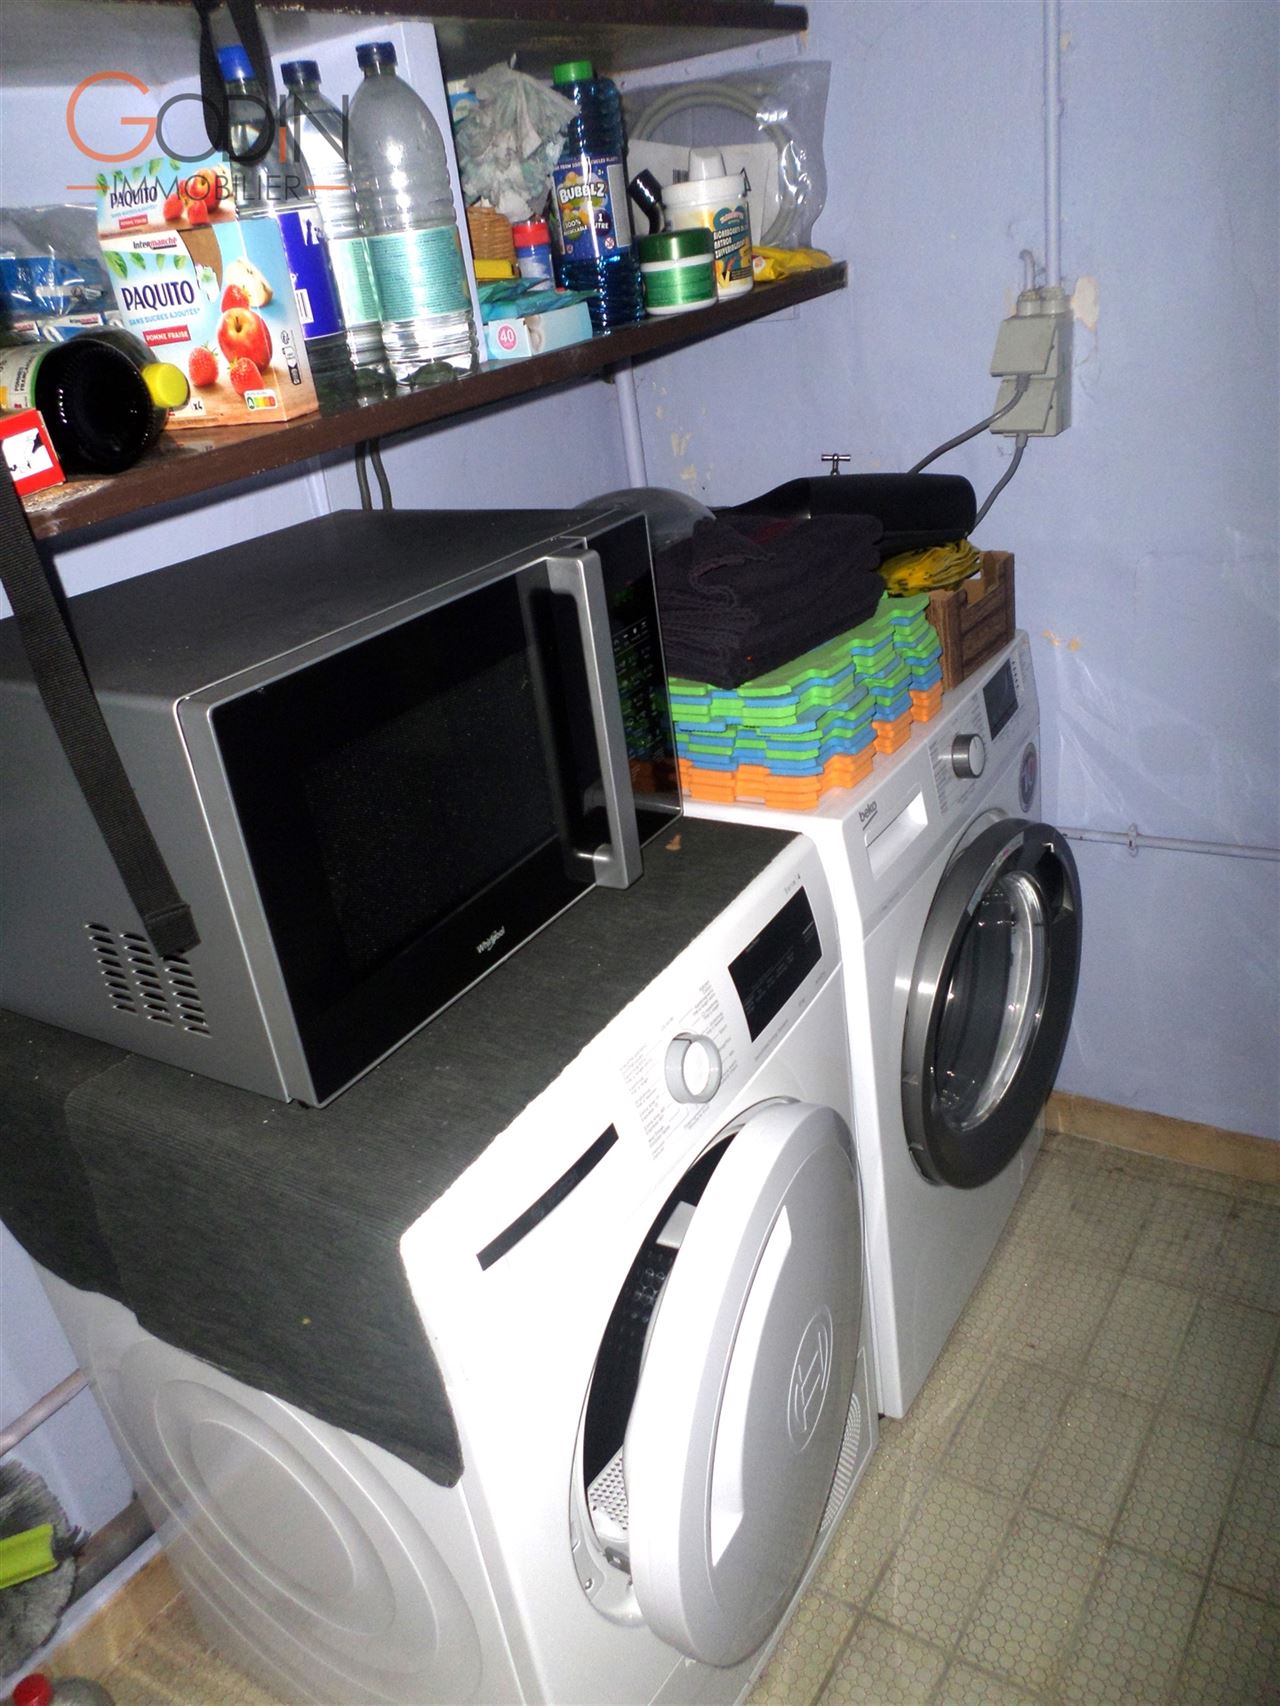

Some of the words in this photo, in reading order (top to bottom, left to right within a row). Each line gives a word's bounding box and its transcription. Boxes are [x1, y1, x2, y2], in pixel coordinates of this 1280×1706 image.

[110, 186, 158, 209] PAQUITO
[559, 183, 605, 204] BUBBLZ
[598, 213, 603, 222] 1
[594, 222, 609, 230] ITRE
[133, 236, 178, 250] Intermarché
[121, 280, 195, 312] PAQUITO
[146, 333, 167, 342] POMME
[168, 330, 189, 339] FRAISE
[500, 328, 515, 343] 40
[858, 801, 878, 823] beko
